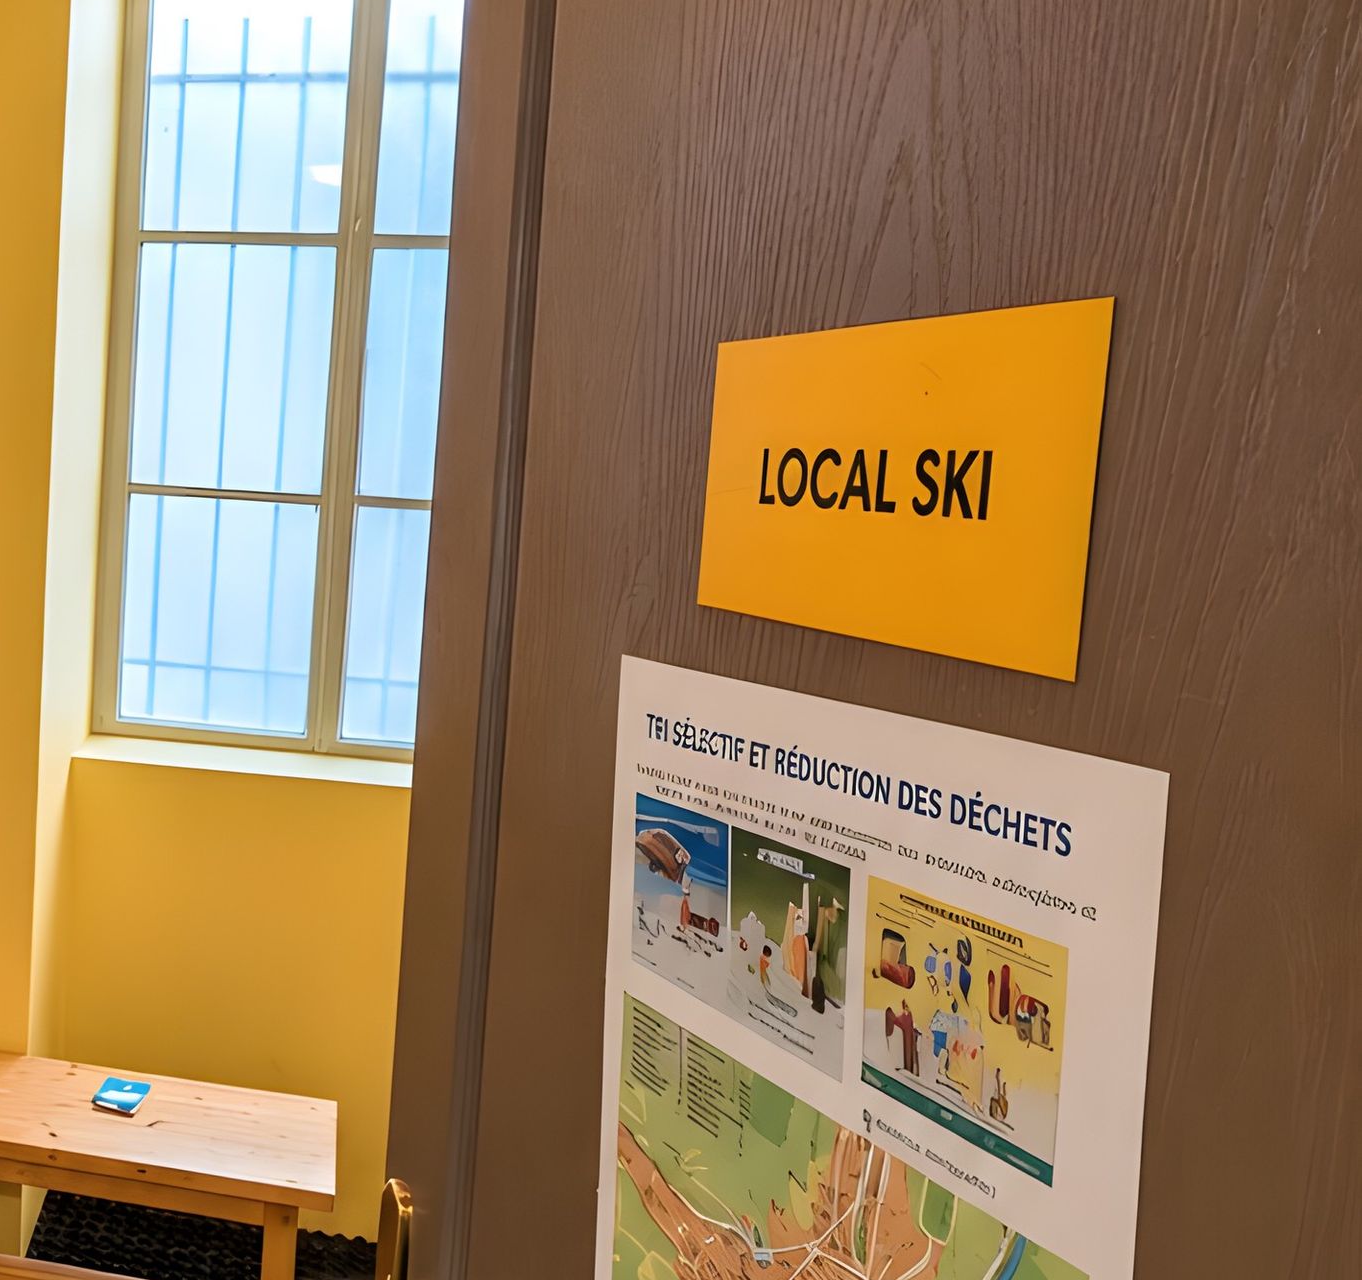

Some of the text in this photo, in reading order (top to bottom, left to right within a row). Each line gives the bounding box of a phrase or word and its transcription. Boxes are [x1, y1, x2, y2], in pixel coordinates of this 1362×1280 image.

[758, 447, 995, 521] LOCAL SKI
[749, 740, 771, 771] ET
[774, 745, 892, 805] RÉDUCTION
[897, 780, 943, 820] DES
[949, 791, 1073, 857] DÉCHETS
